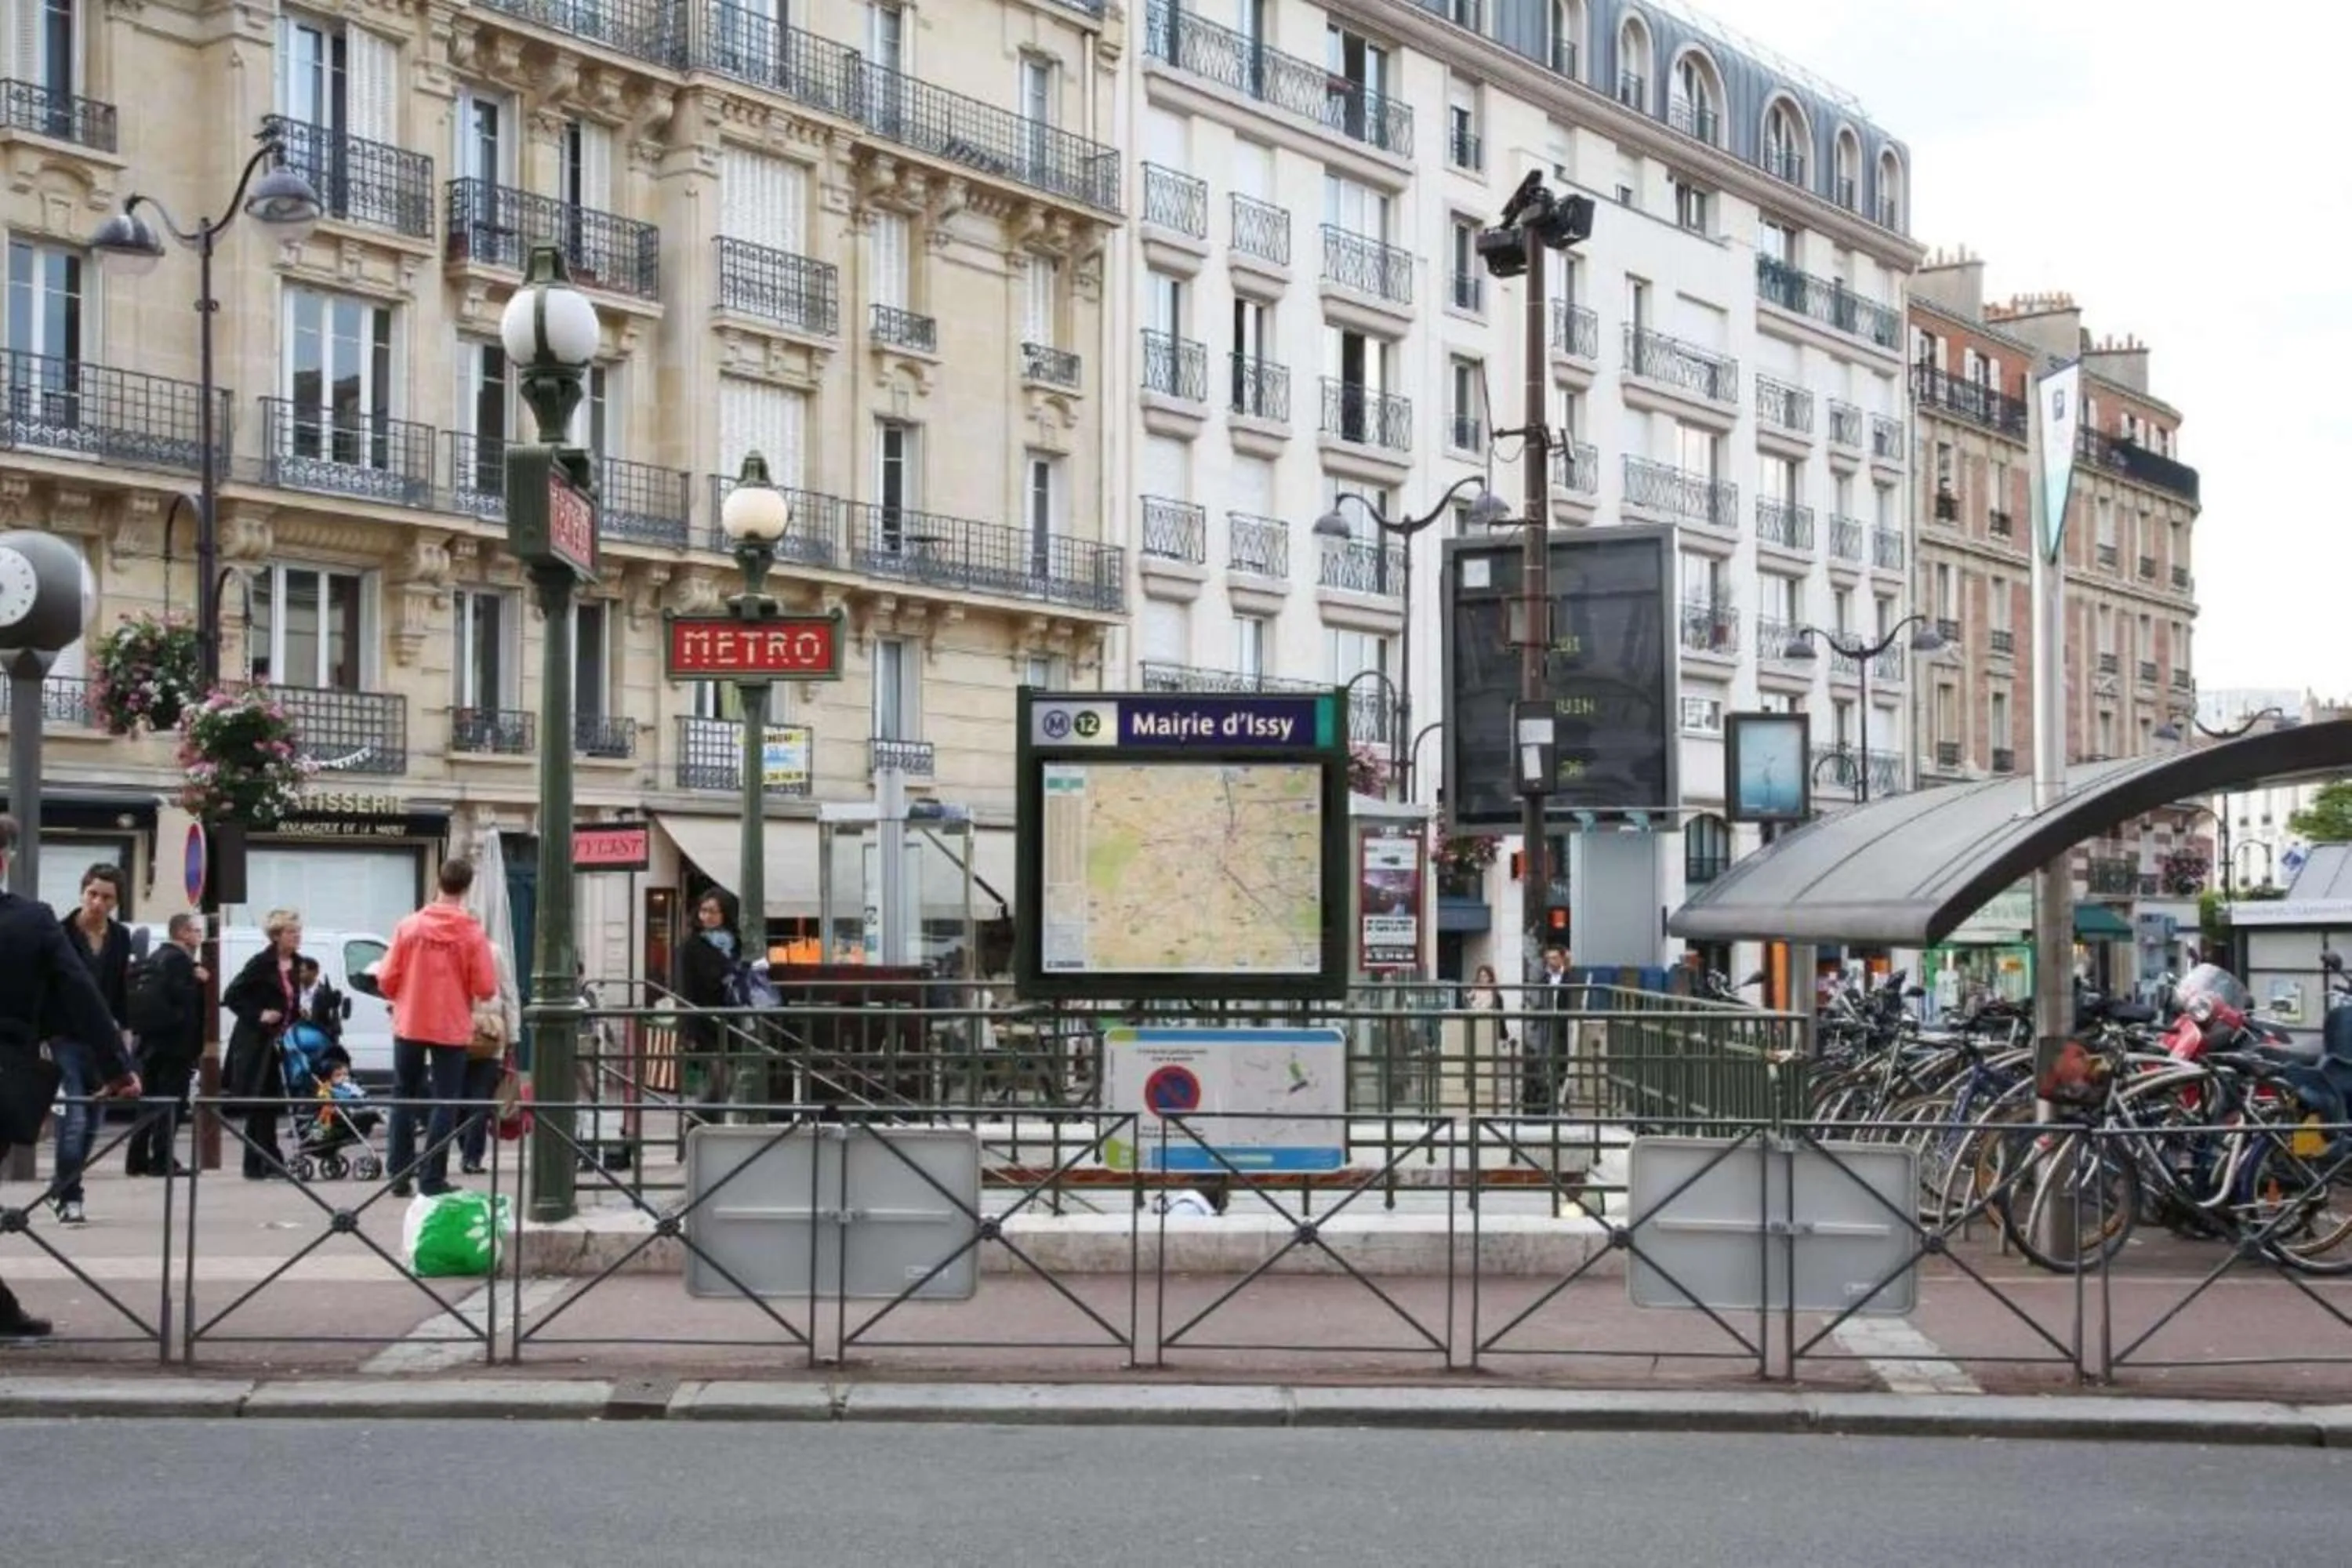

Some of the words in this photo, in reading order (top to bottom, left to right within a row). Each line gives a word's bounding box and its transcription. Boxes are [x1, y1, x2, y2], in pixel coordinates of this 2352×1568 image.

[684, 631, 821, 664] METRO
[1078, 717, 1097, 732] 12
[1132, 712, 1214, 735] Mairie
[1222, 712, 1294, 742] d'Issy
[296, 793, 409, 815] TISSERIE
